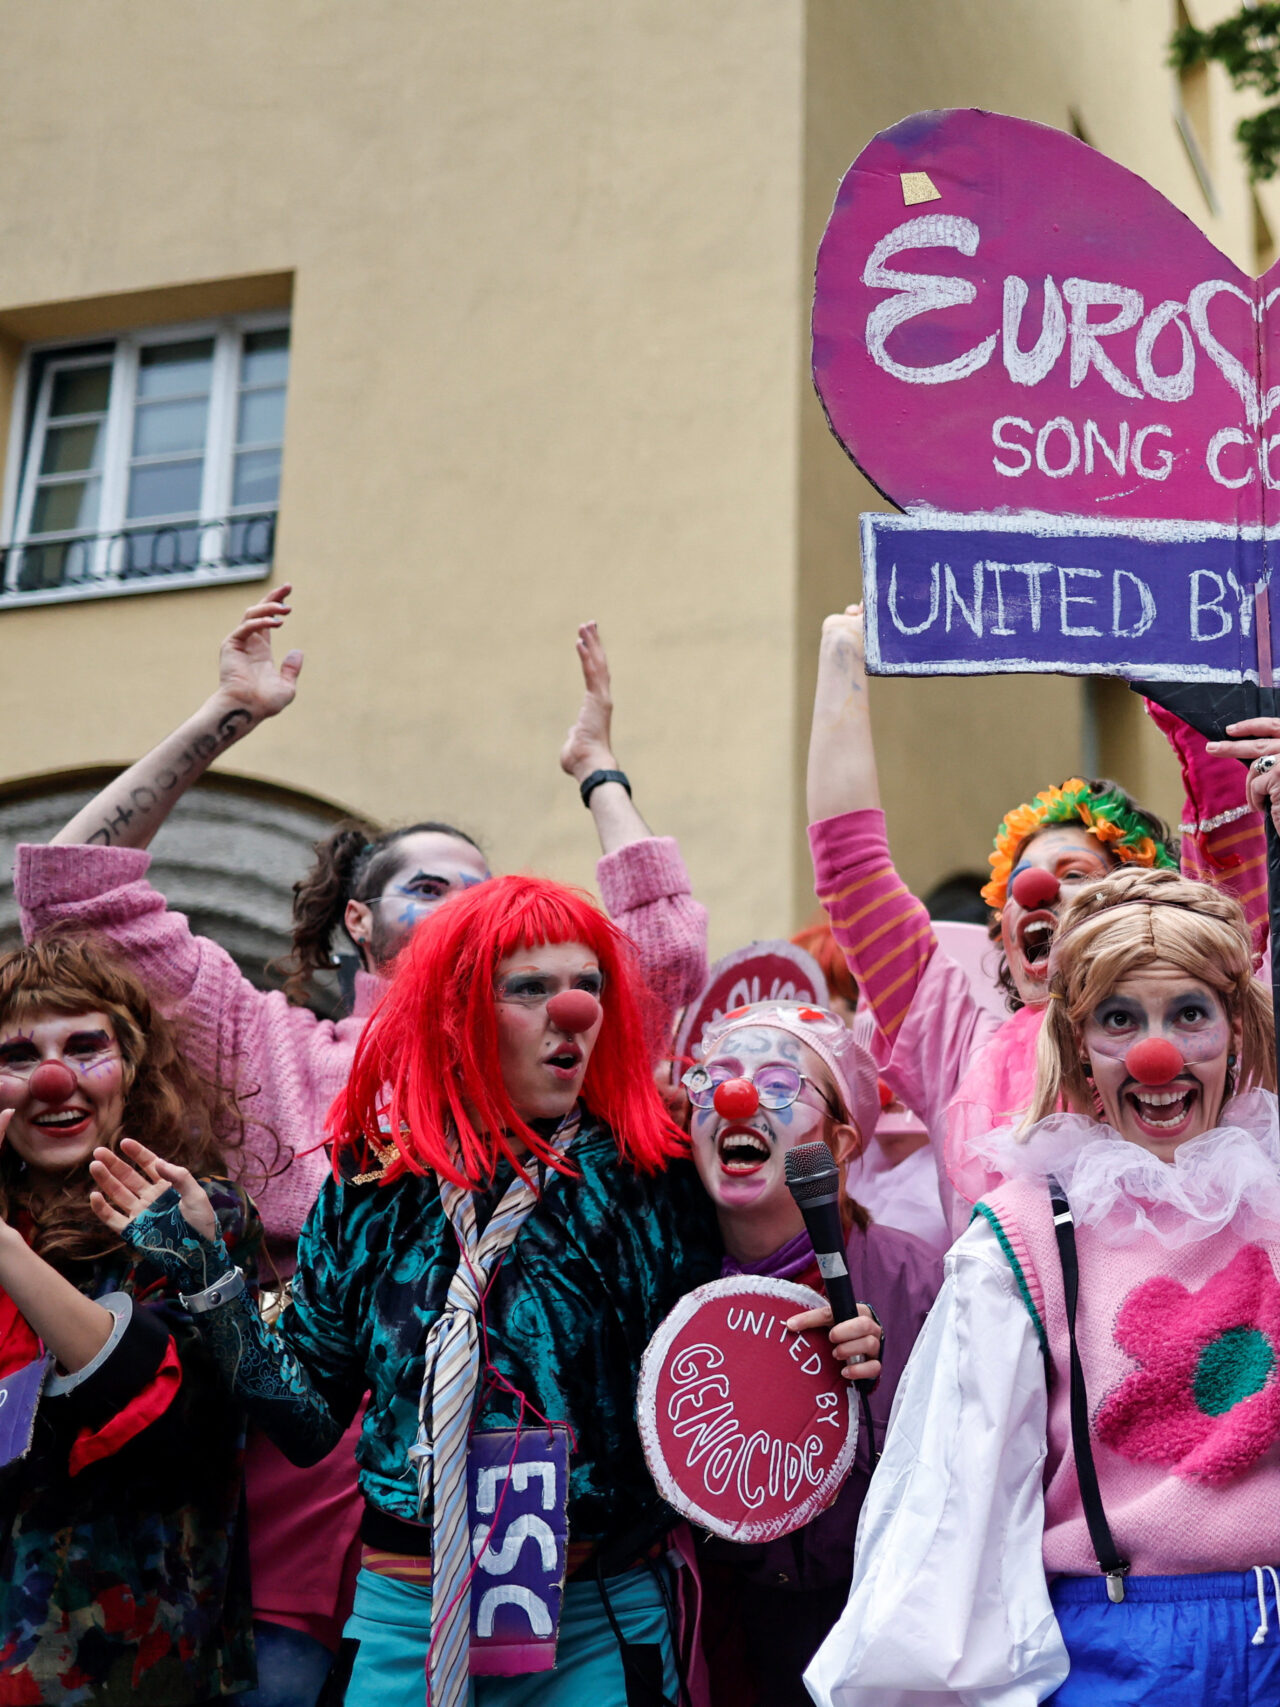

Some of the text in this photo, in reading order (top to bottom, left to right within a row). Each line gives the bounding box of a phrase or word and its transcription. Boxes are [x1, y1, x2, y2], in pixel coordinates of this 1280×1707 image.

[991, 415, 1174, 481] SONG
[888, 560, 1157, 638] UNITED
[1188, 567, 1272, 642] BY
[727, 1307, 840, 1428] UNITED BY
[472, 1461, 558, 1639] ESC
